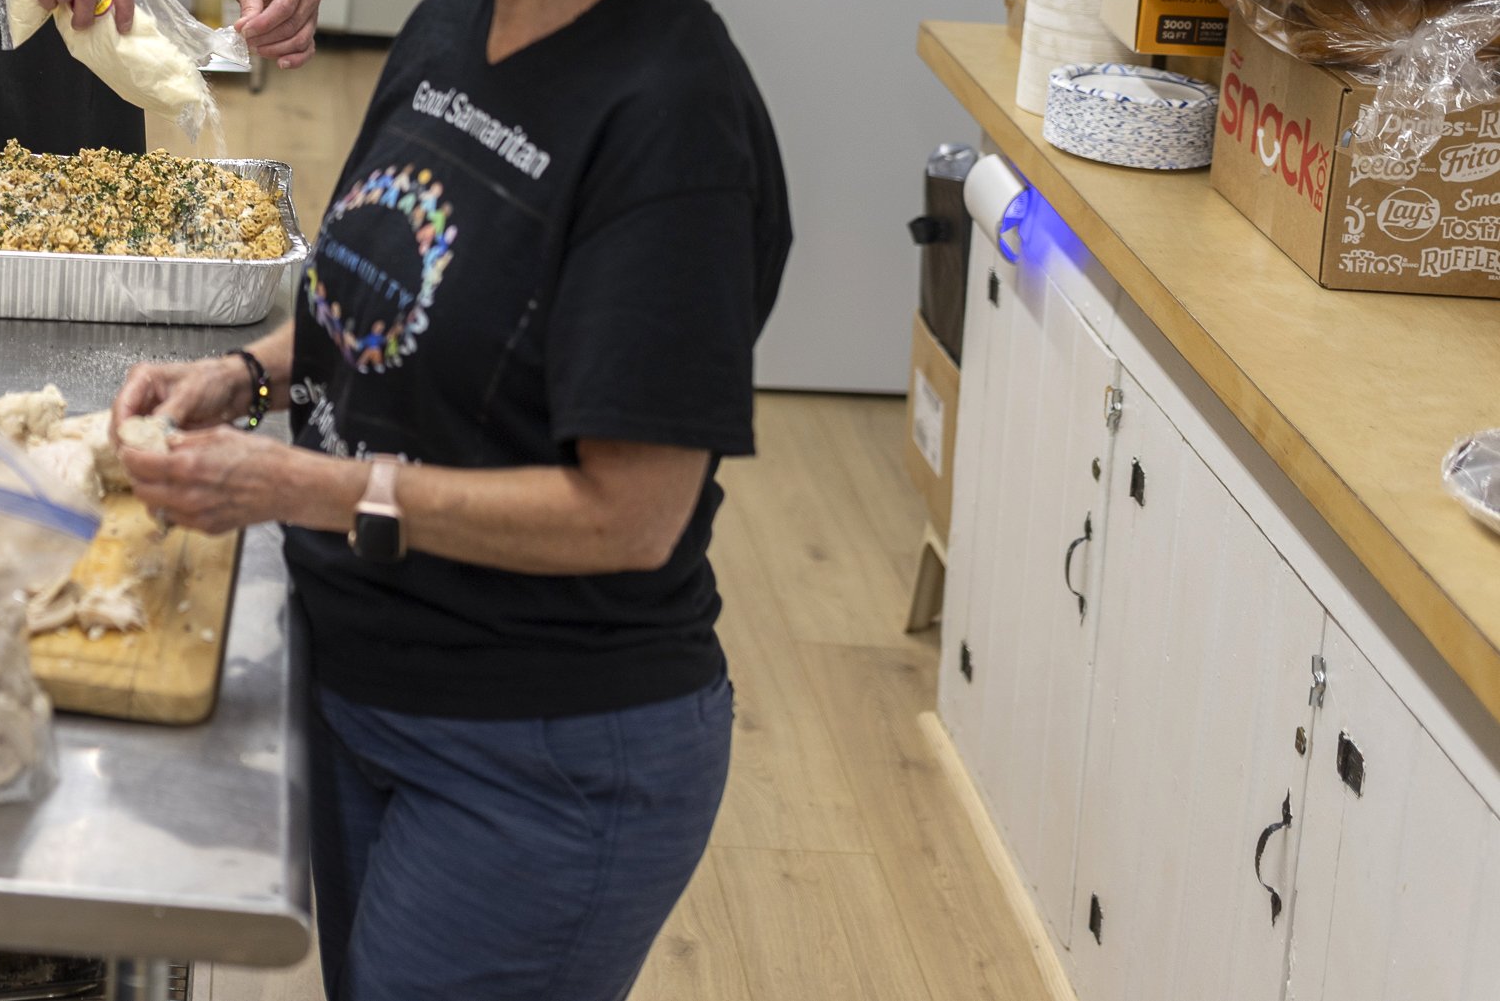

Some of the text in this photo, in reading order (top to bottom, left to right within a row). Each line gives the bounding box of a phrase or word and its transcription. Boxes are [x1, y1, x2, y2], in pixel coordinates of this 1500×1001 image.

[1162, 30, 1188, 40] SQ FT
[1163, 20, 1192, 30] 3000
[1200, 21, 1224, 31] 2000
[412, 79, 551, 180] Good Samaritan
[1221, 72, 1320, 203] snack
[1314, 144, 1329, 213] BOX
[1381, 200, 1436, 229] Lay's
